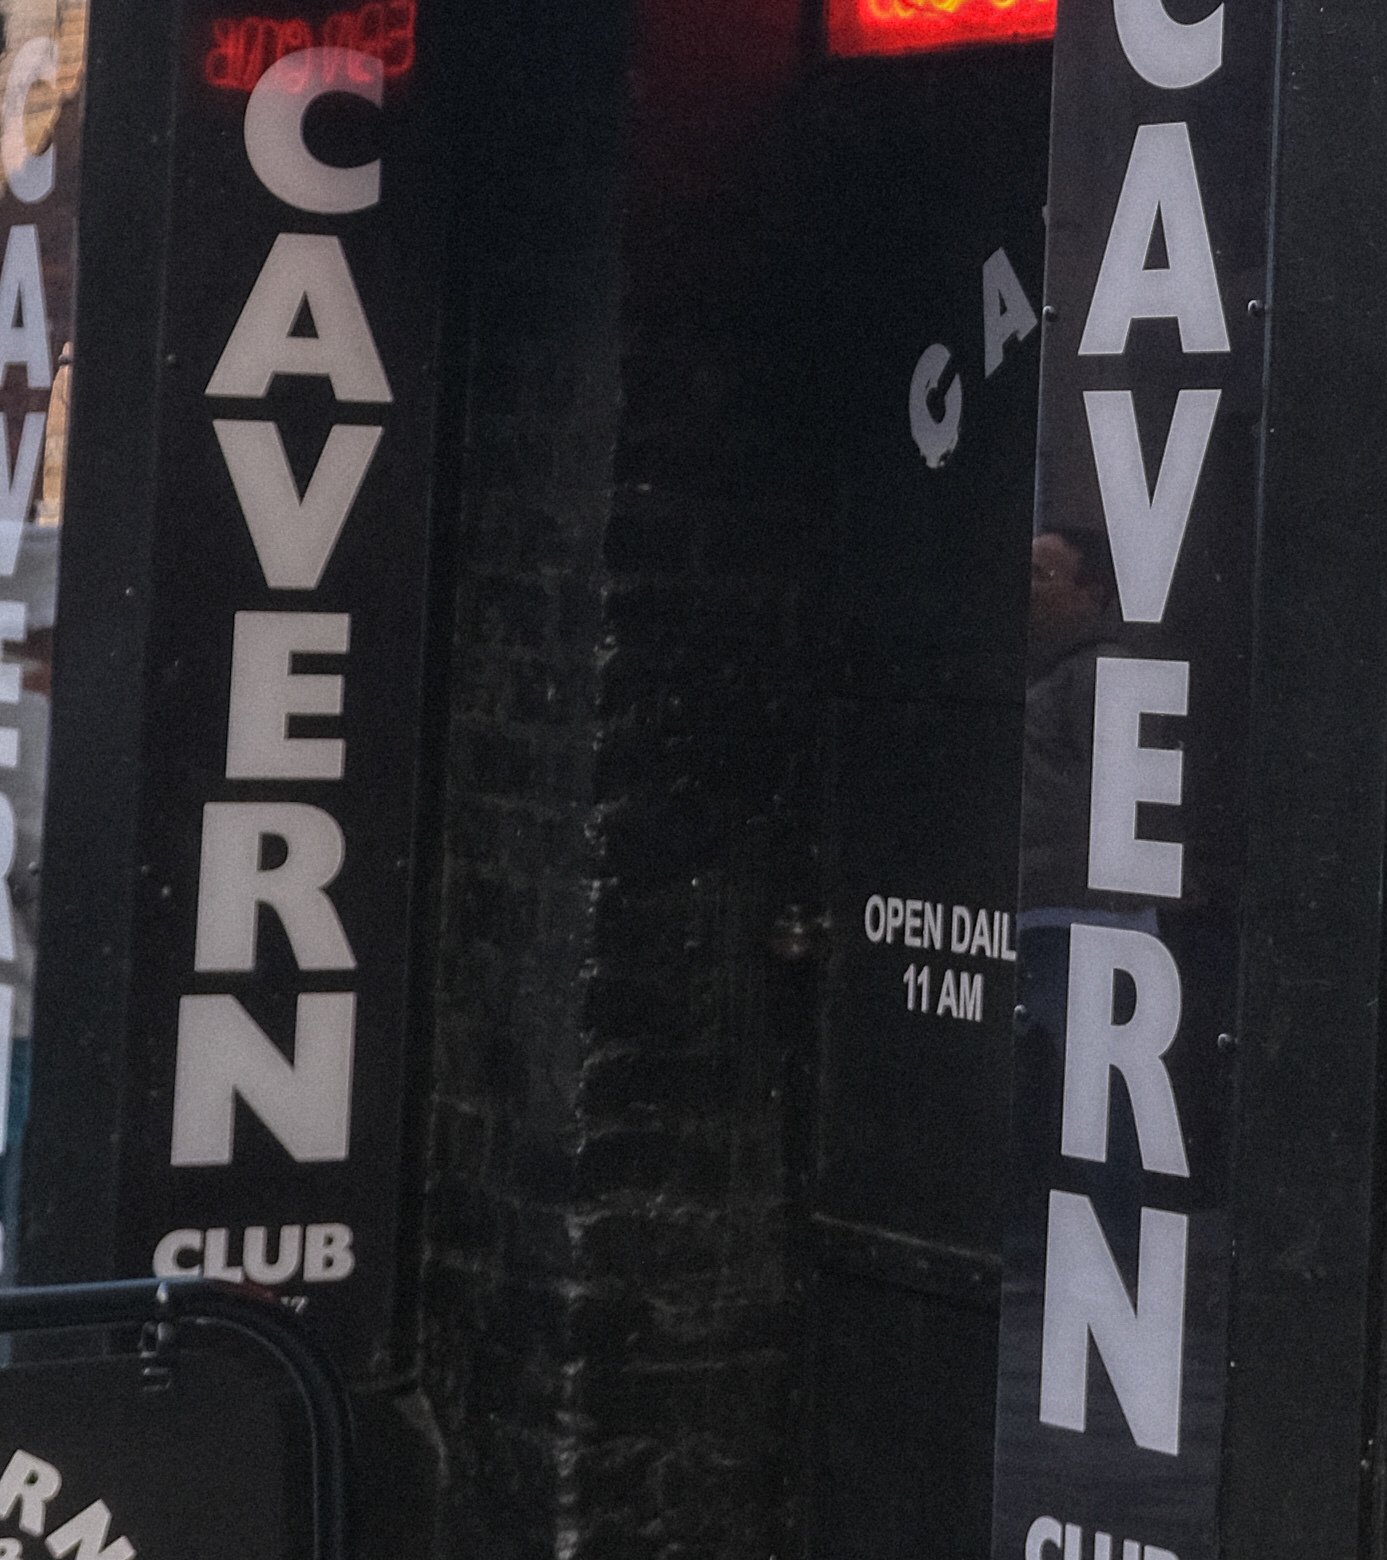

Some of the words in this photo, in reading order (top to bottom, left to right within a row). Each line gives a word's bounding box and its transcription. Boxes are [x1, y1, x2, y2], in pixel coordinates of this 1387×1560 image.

[171, 44, 393, 1166] CAVERN
[864, 894, 943, 950] OPEN
[903, 963, 929, 1014] 11
[936, 969, 983, 1023] AM
[153, 1222, 355, 1285] CLUB
